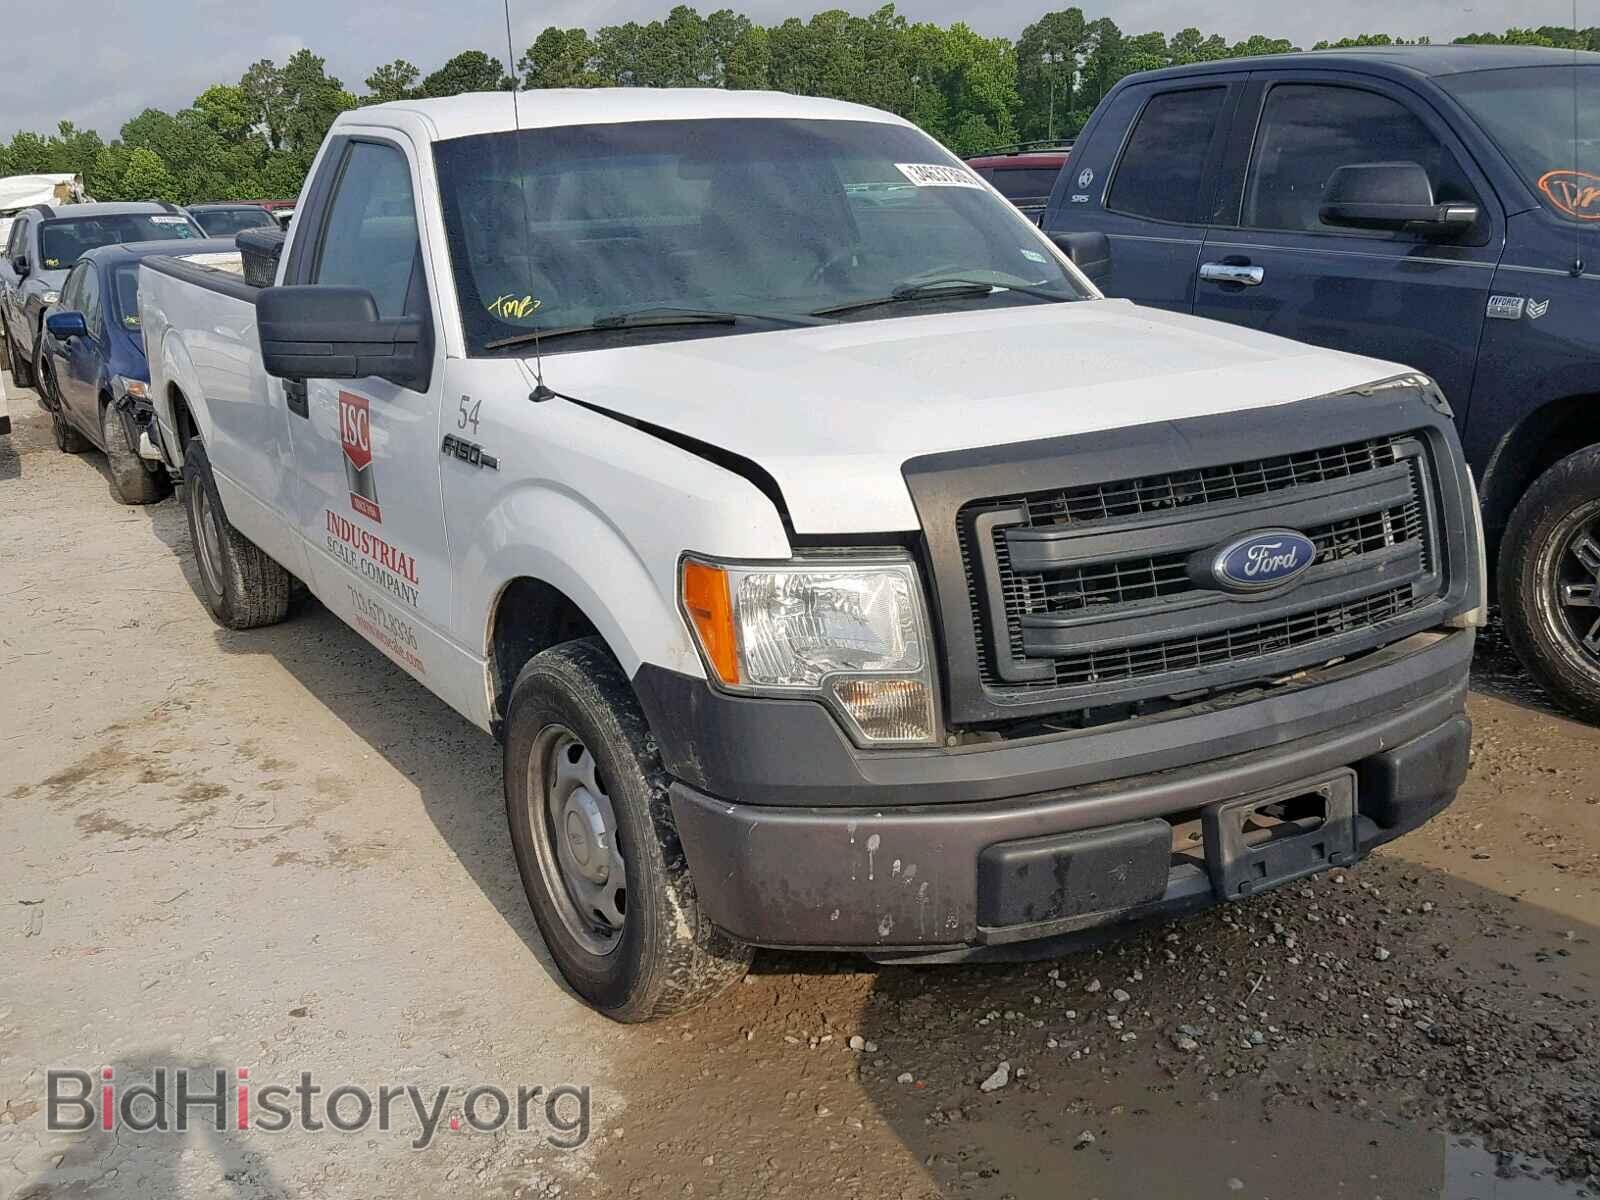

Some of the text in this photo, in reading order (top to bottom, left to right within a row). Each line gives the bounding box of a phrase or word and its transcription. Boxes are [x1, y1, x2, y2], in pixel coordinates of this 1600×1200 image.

[341, 402, 369, 451] ISC
[458, 395, 482, 434] 54
[325, 509, 419, 585] INDUSTRIAL
[1244, 542, 1297, 576] Ford
[327, 536, 420, 609] SCALE COMPANY
